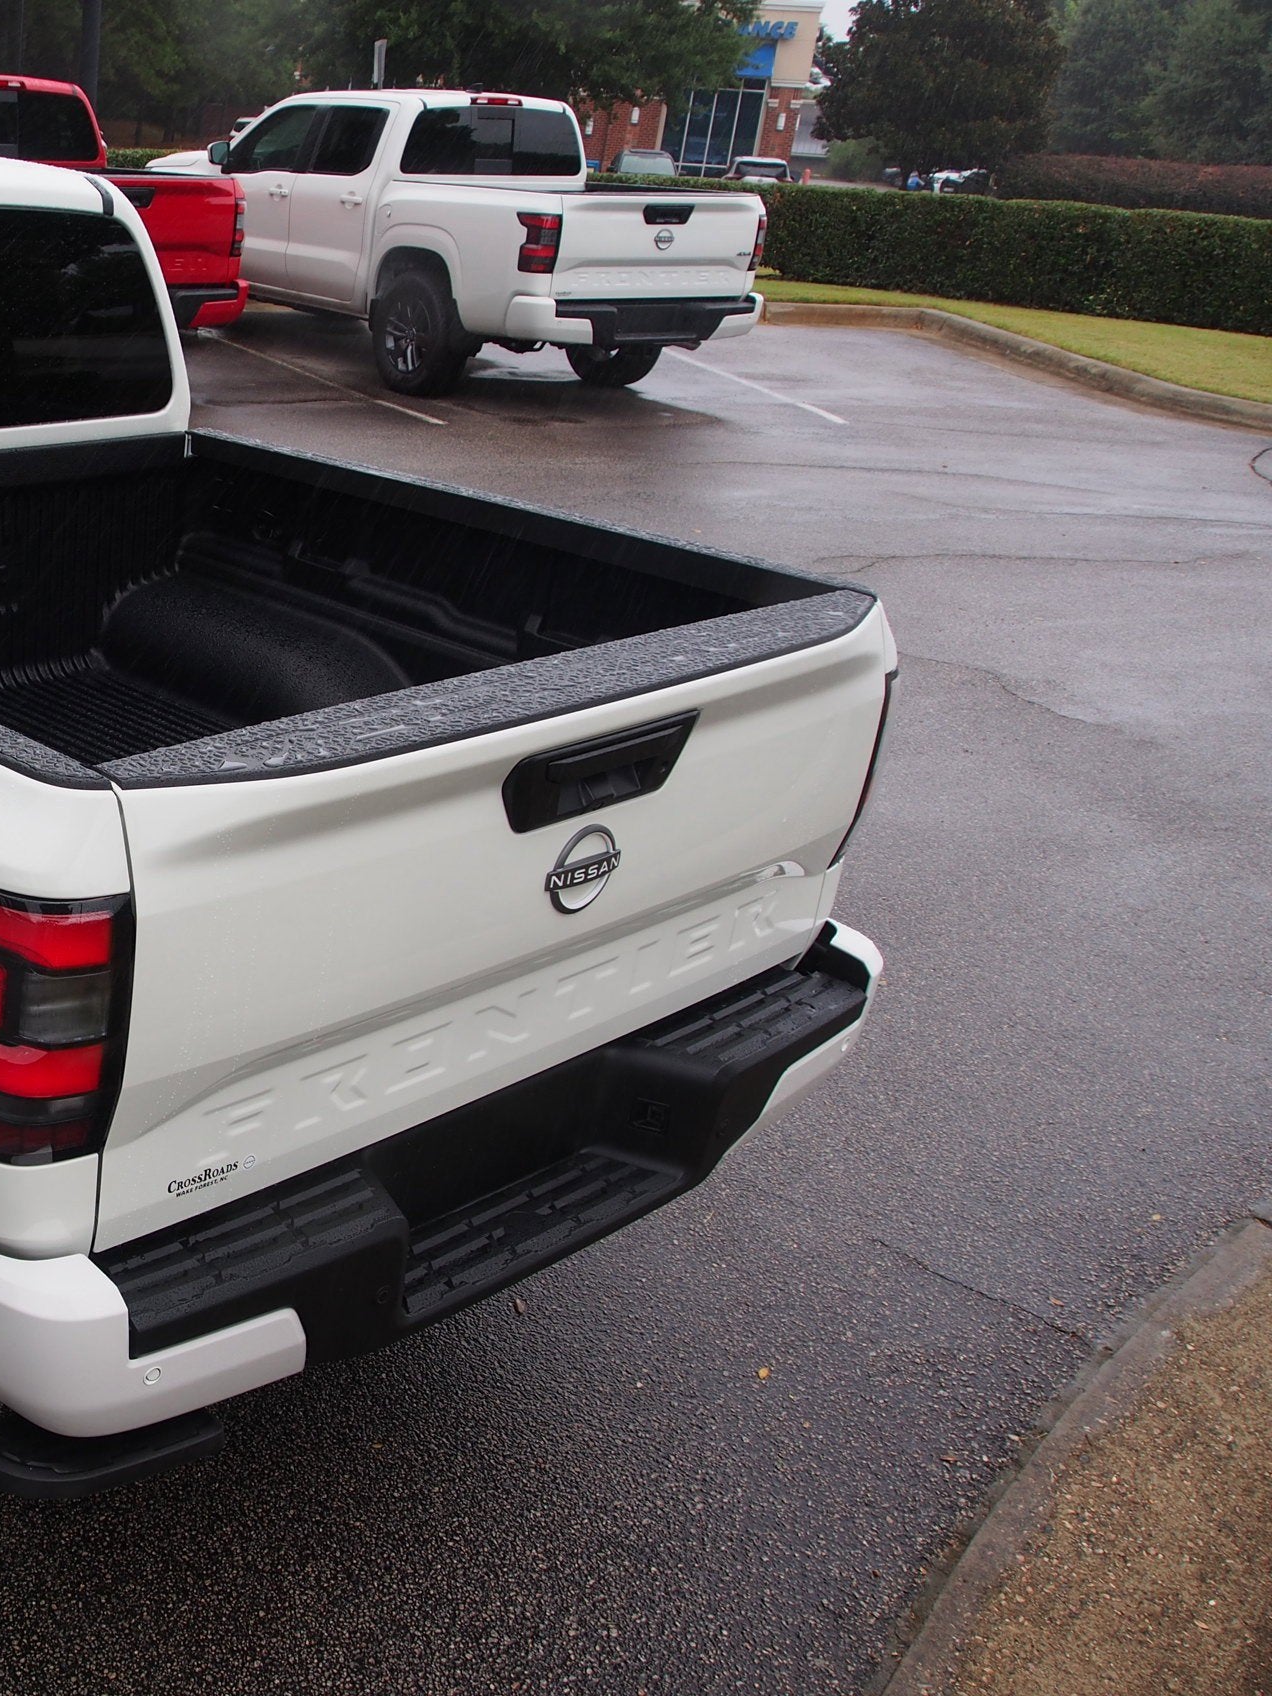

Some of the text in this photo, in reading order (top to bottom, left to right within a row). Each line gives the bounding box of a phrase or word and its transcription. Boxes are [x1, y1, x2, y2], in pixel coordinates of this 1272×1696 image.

[549, 853, 620, 889] NISSAN
[195, 890, 783, 1168] FRONTIER
[175, 1175, 229, 1198] WAKE FOREST, NC
